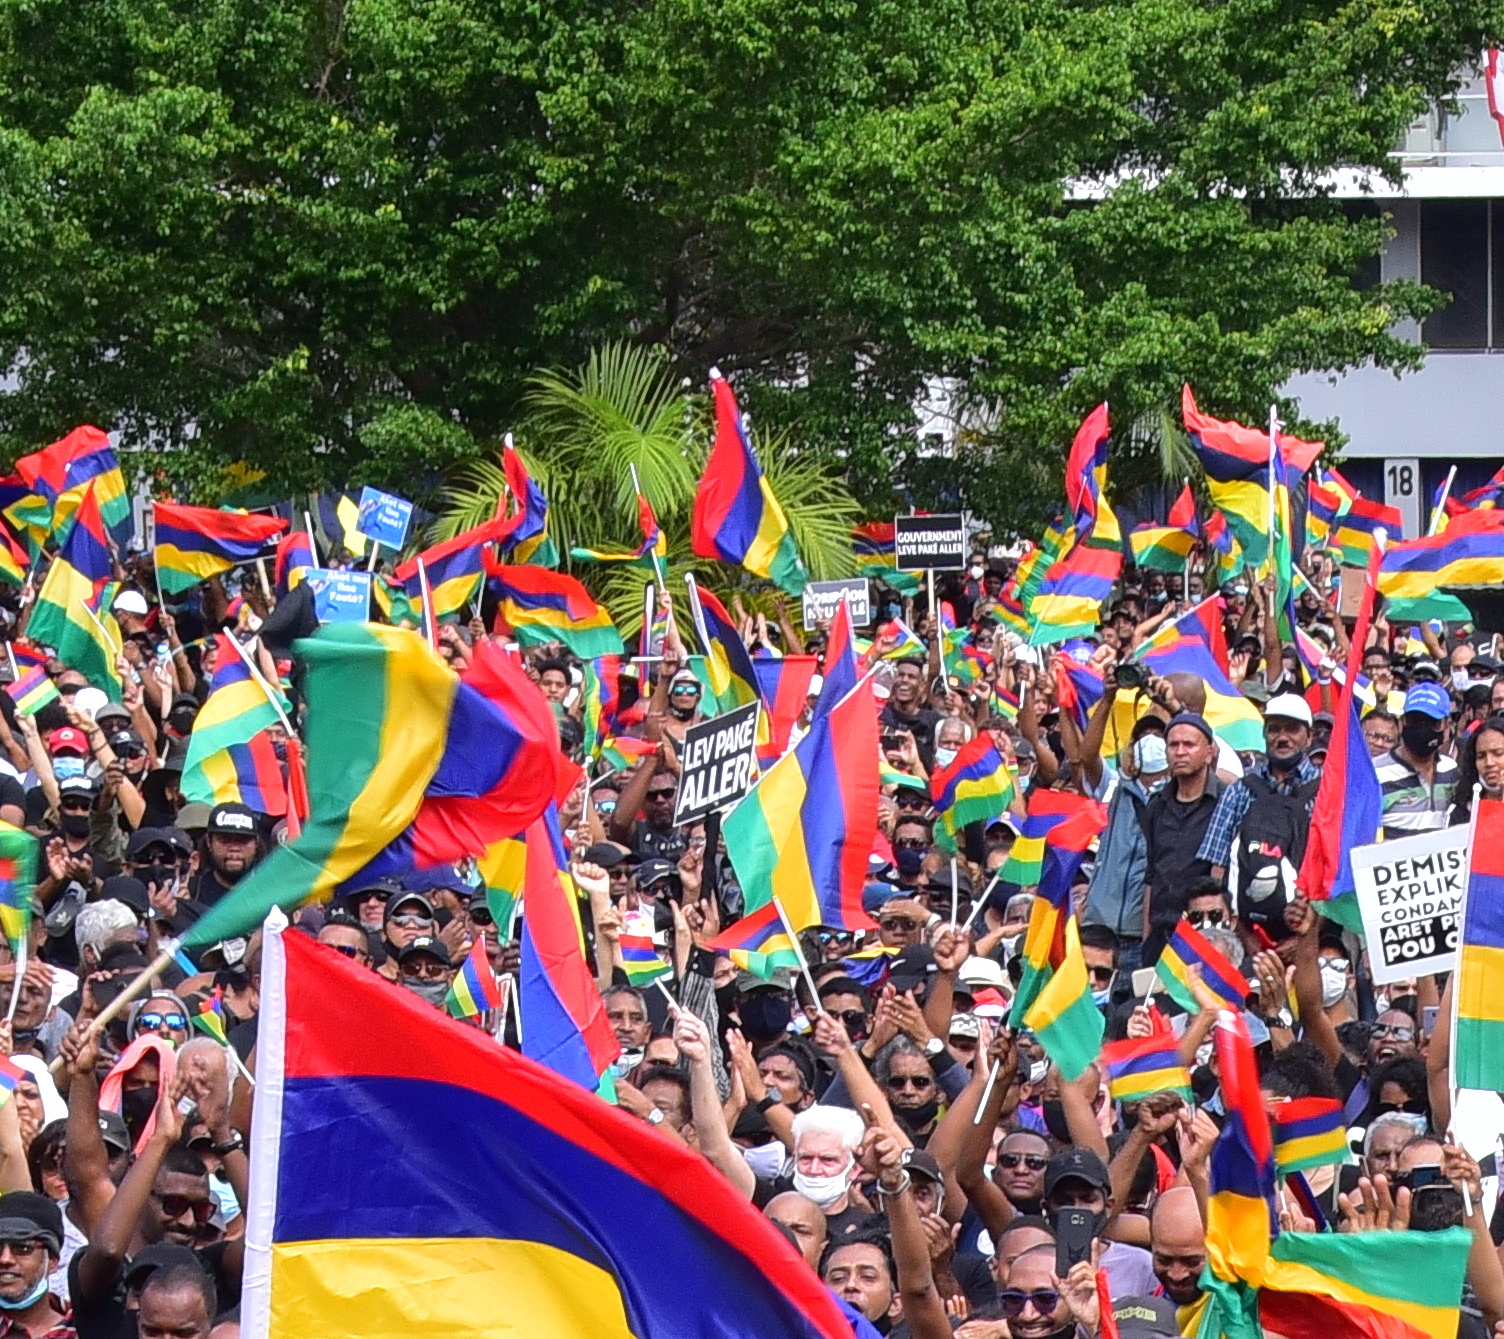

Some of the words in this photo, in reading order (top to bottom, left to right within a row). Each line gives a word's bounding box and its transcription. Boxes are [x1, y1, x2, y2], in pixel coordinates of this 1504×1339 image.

[1387, 466, 1414, 497] 18
[684, 732, 713, 772] LEV
[714, 711, 755, 760] PAKÉ
[678, 751, 750, 816] ALLER
[1249, 841, 1282, 859] FILA
[1373, 848, 1466, 886] DEMIS
[1384, 920, 1434, 942] ARET
[1386, 935, 1436, 963] POU
